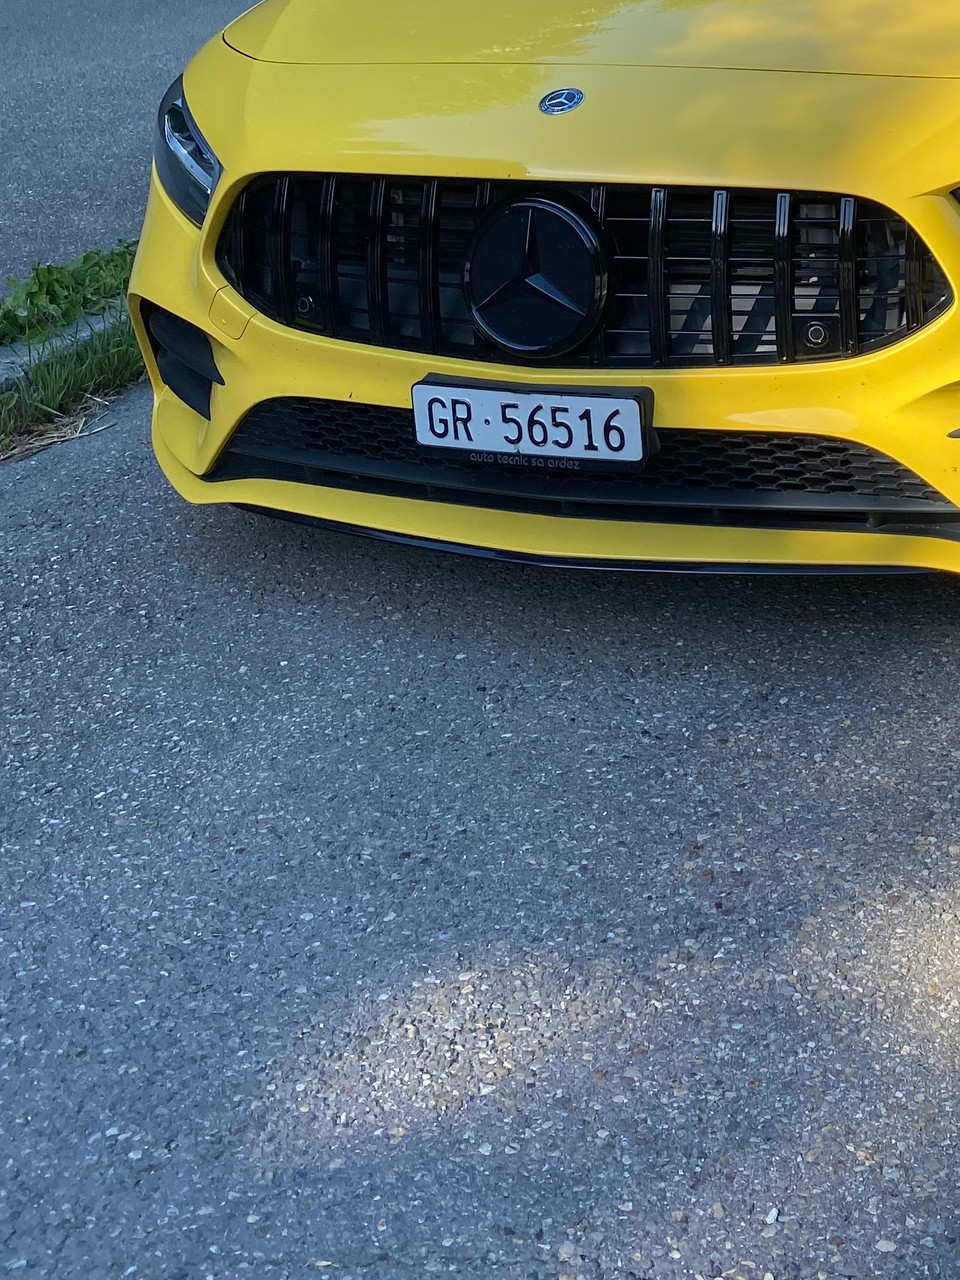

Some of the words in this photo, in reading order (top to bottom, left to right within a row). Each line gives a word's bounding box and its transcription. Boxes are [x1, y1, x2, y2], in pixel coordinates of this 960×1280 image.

[469, 452, 495, 463] auto
[497, 454, 528, 466] tecnic
[531, 458, 544, 467] sa
[547, 458, 580, 470] ardez
